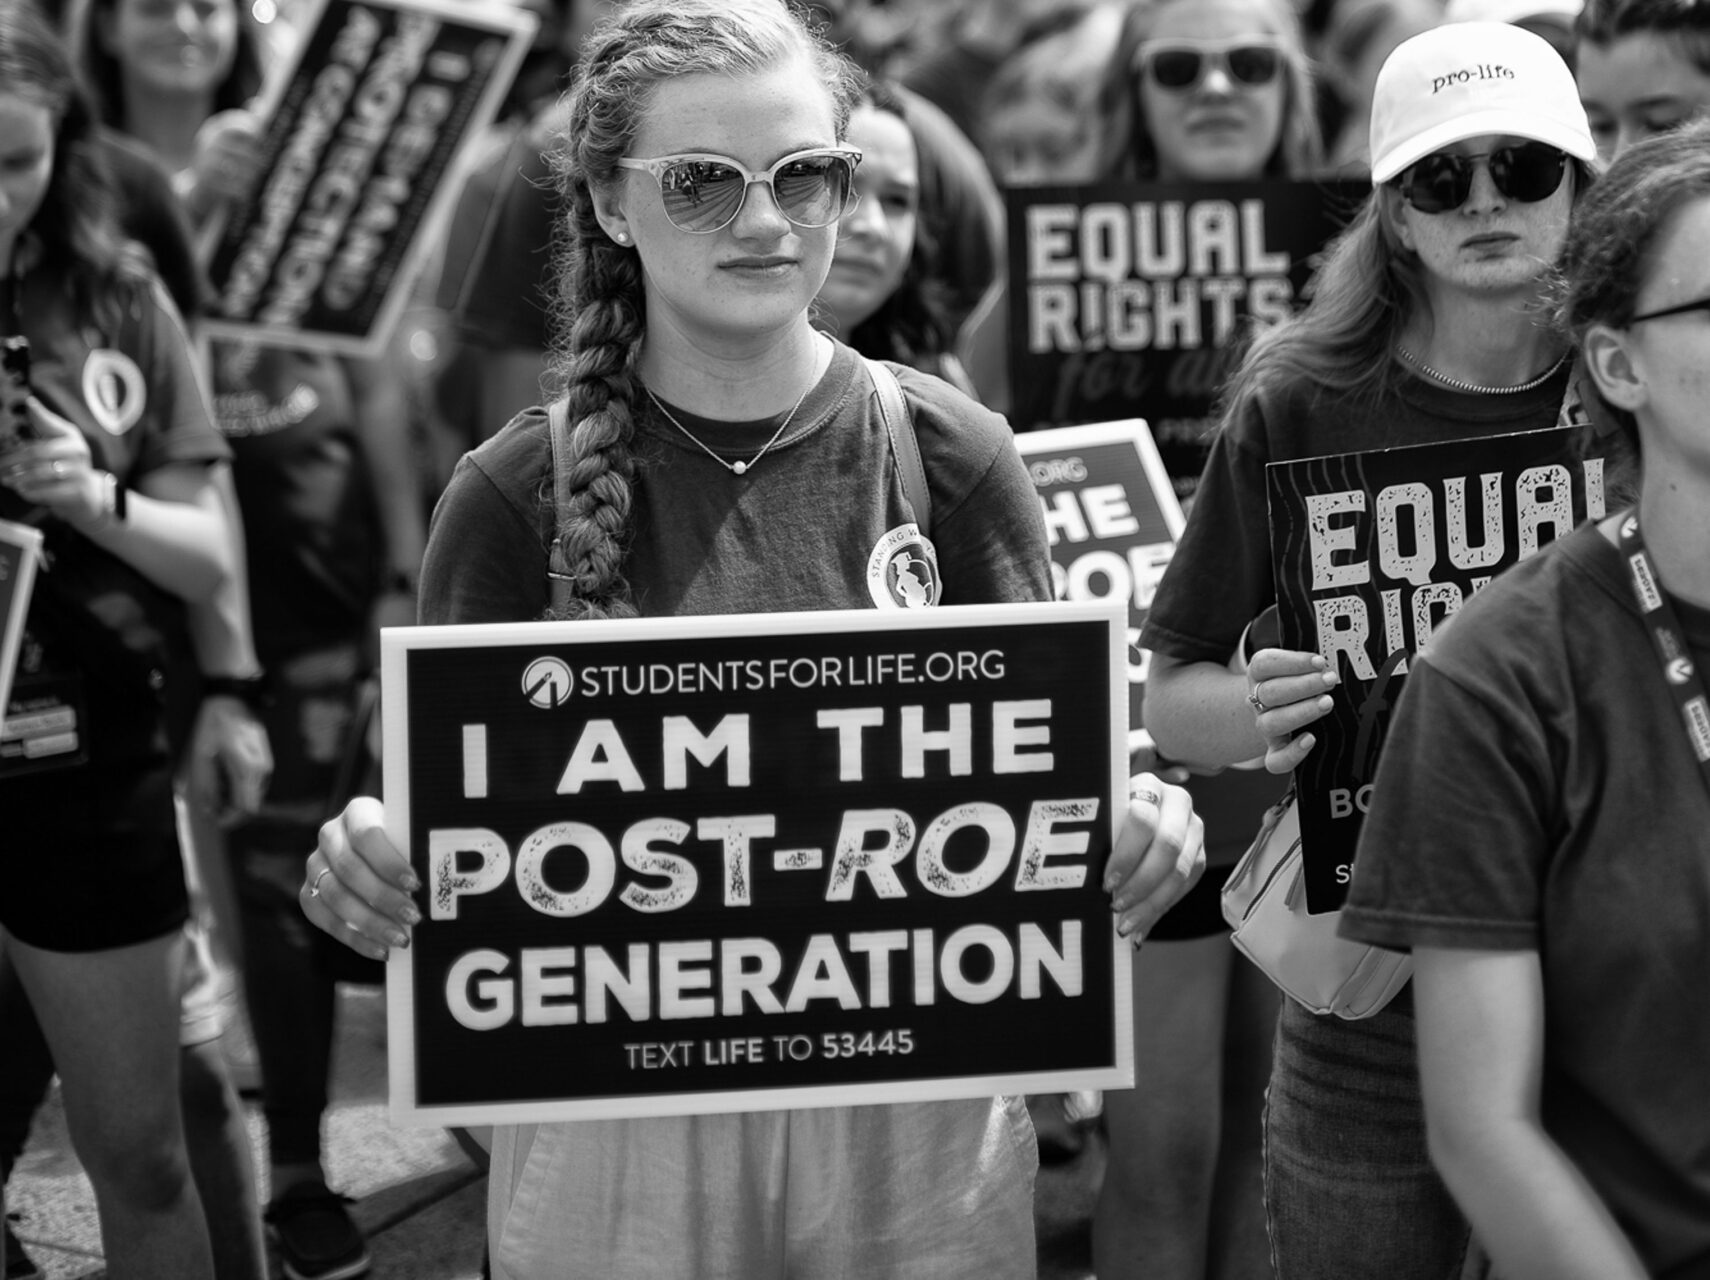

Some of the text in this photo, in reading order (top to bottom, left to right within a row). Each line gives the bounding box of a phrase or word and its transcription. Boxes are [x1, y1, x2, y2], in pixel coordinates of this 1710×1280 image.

[1432, 64, 1515, 95] pro-life
[1027, 199, 1290, 283] EQUAL
[1028, 275, 1293, 354] RIGHTS
[1039, 484, 1140, 546] HE
[581, 650, 1005, 697] STUDENTSFORLIFE.ORG
[462, 699, 1055, 799] I AM THE
[428, 797, 1101, 921] POST-ROE
[445, 919, 1083, 1031] GENERATION
[624, 1029, 914, 1069] TEXT LIFE TO 53445
